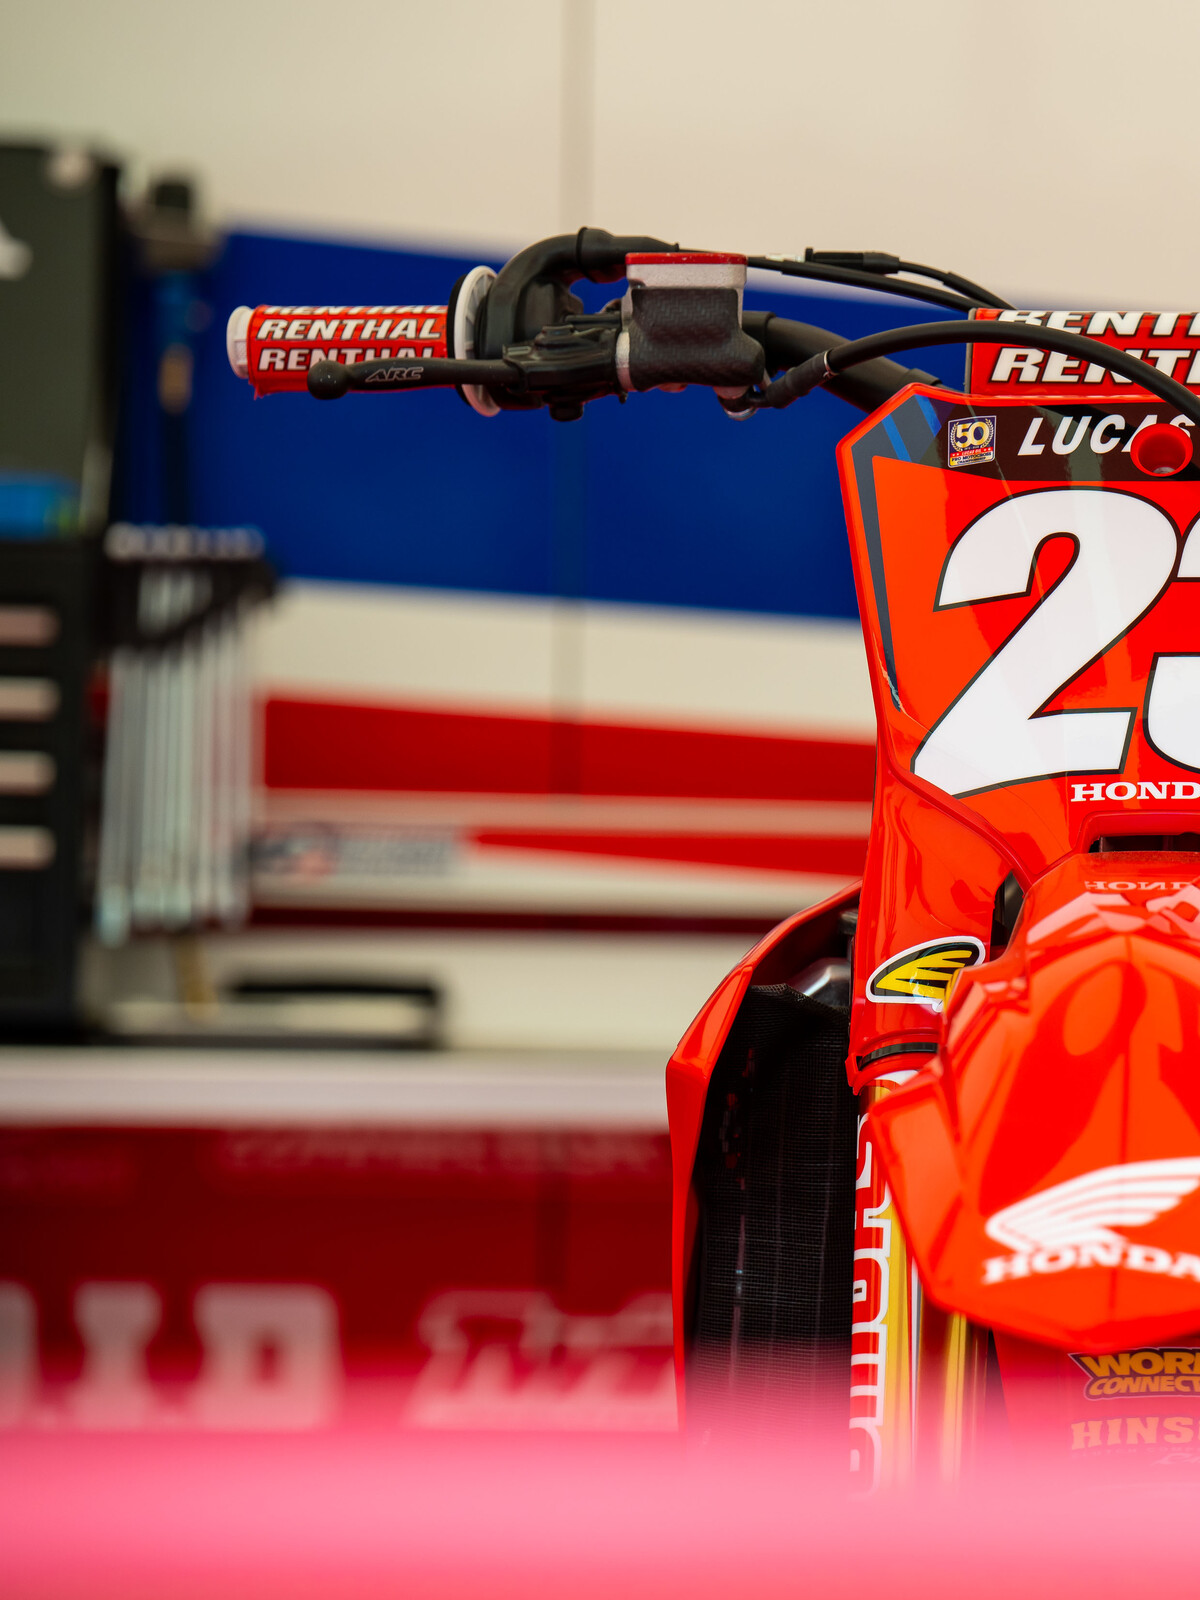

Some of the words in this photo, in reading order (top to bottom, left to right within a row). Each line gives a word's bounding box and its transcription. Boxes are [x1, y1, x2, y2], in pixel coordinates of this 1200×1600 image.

[256, 318, 442, 341] RENTHAL
[365, 367, 425, 383] ARC
[956, 421, 990, 448] 50
